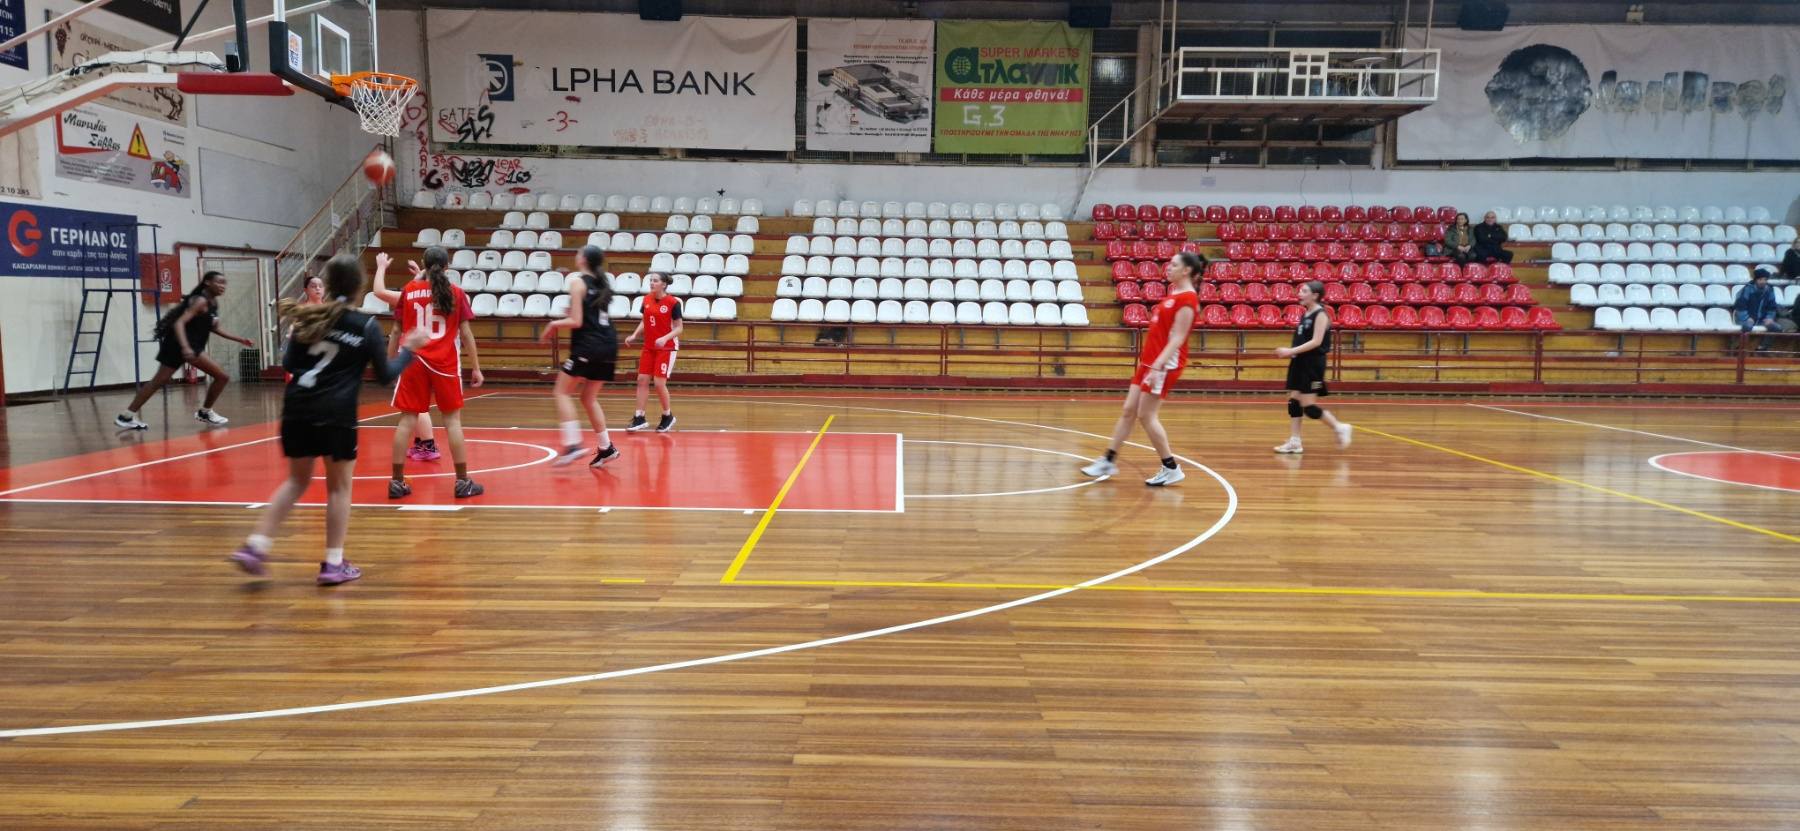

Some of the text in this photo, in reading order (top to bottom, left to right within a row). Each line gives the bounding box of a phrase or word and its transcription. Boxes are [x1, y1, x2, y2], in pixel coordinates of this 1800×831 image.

[981, 48, 1080, 59] SUPER MARKETS
[551, 66, 757, 96] LPHA BANK
[954, 89, 1070, 101] Κάθε μέρα φθηνά!
[50, 227, 128, 248] ΓΕΡΜΑΝΟΣ
[414, 302, 447, 340] 16
[649, 315, 657, 327] 9
[660, 363, 668, 375] 9
